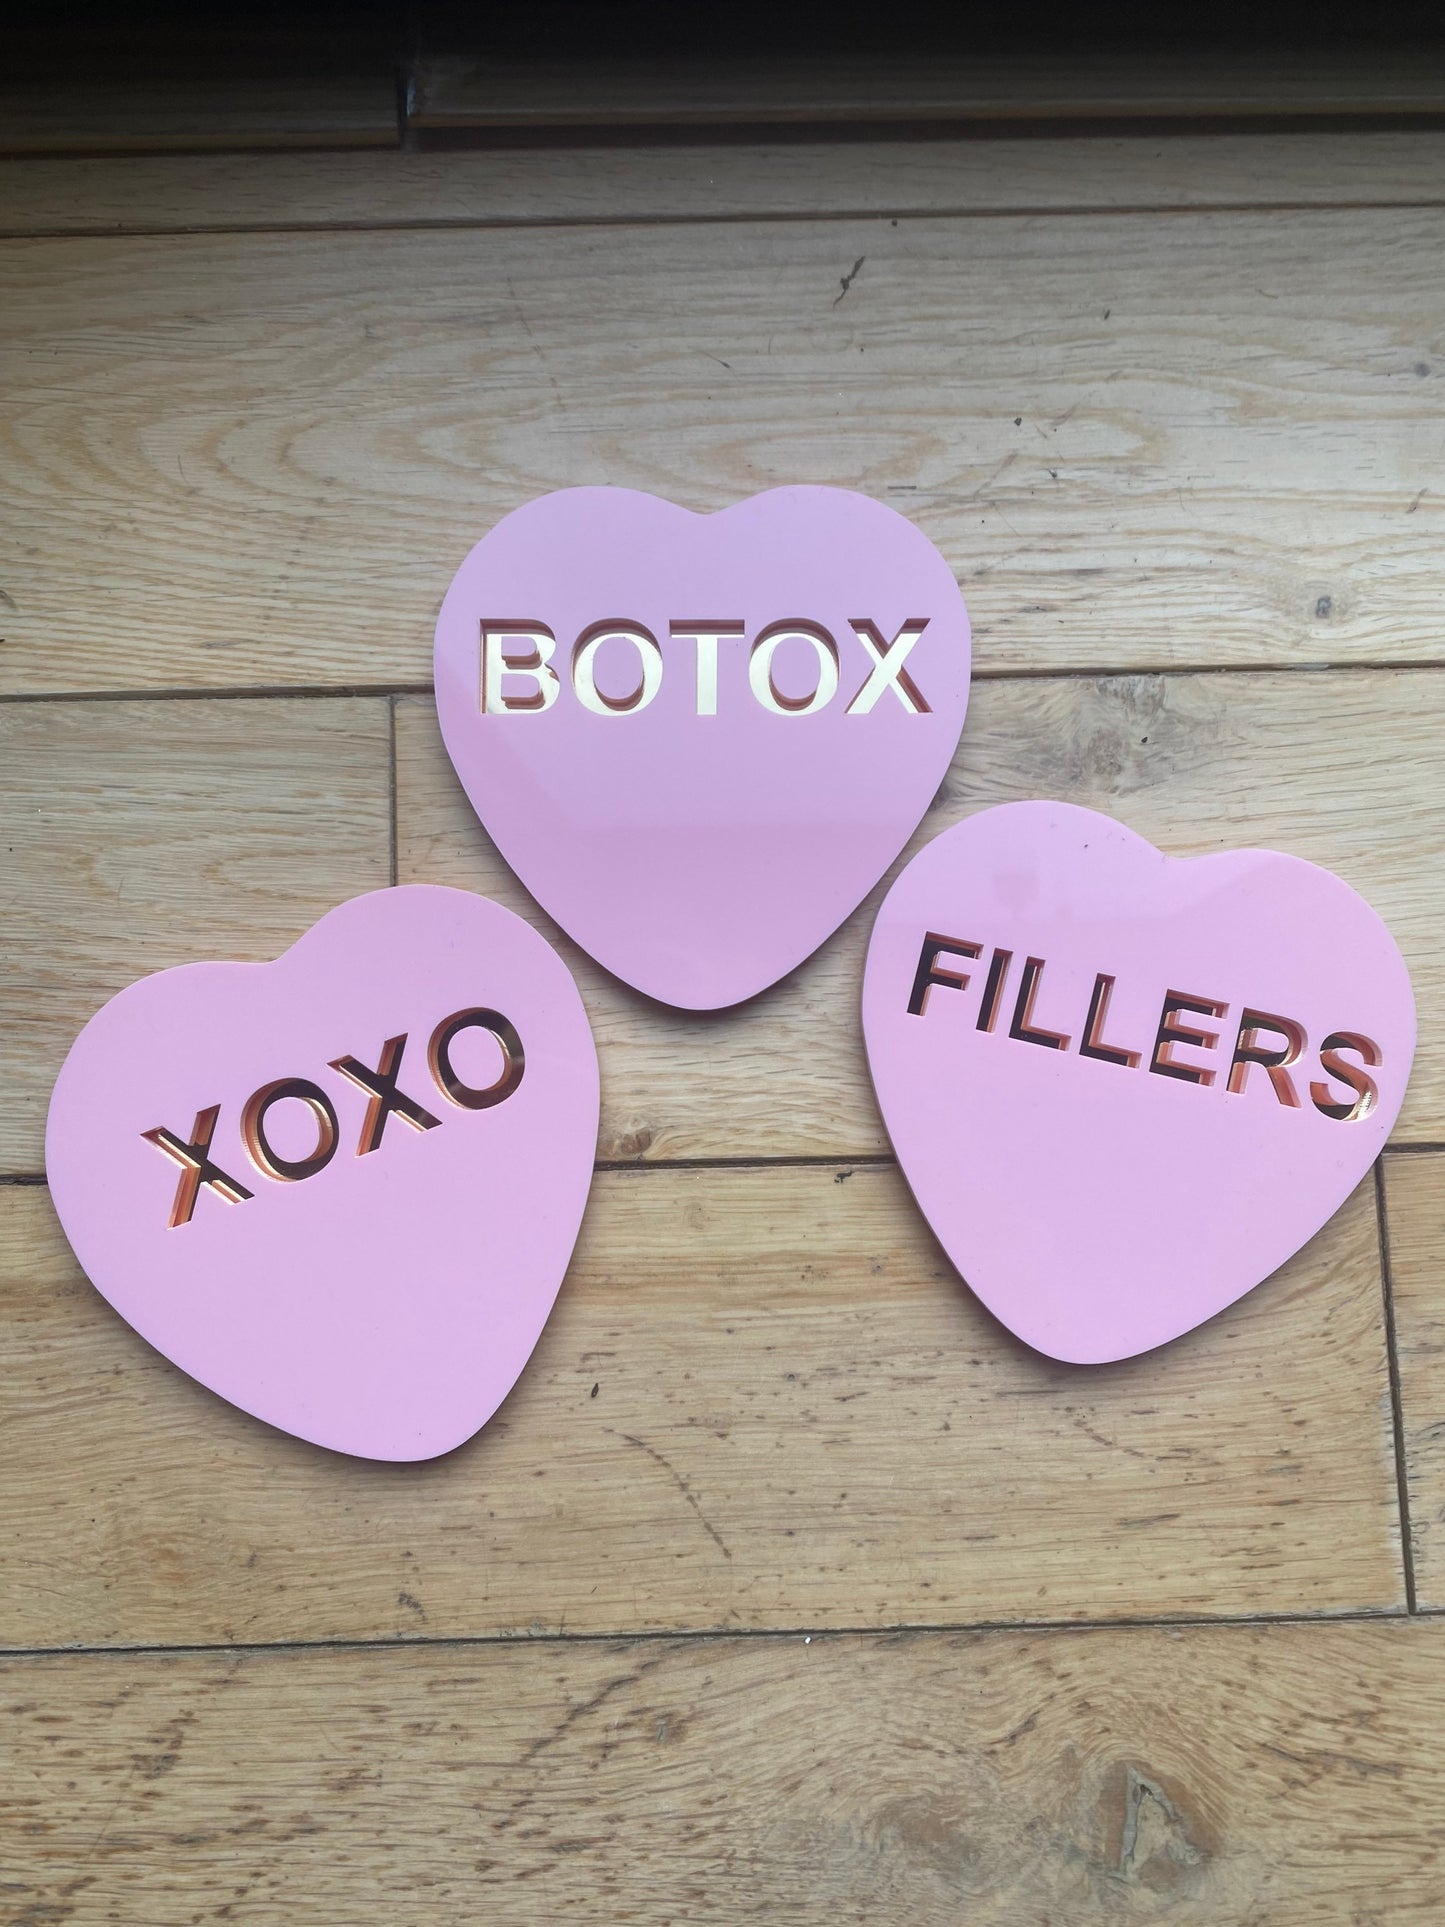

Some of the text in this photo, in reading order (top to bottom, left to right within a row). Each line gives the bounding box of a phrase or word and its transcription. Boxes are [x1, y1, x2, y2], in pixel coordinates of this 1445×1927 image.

[479, 617, 934, 717] BOTOX
[139, 1006, 526, 1230] XOXO
[906, 930, 1384, 1123] FILLERS
